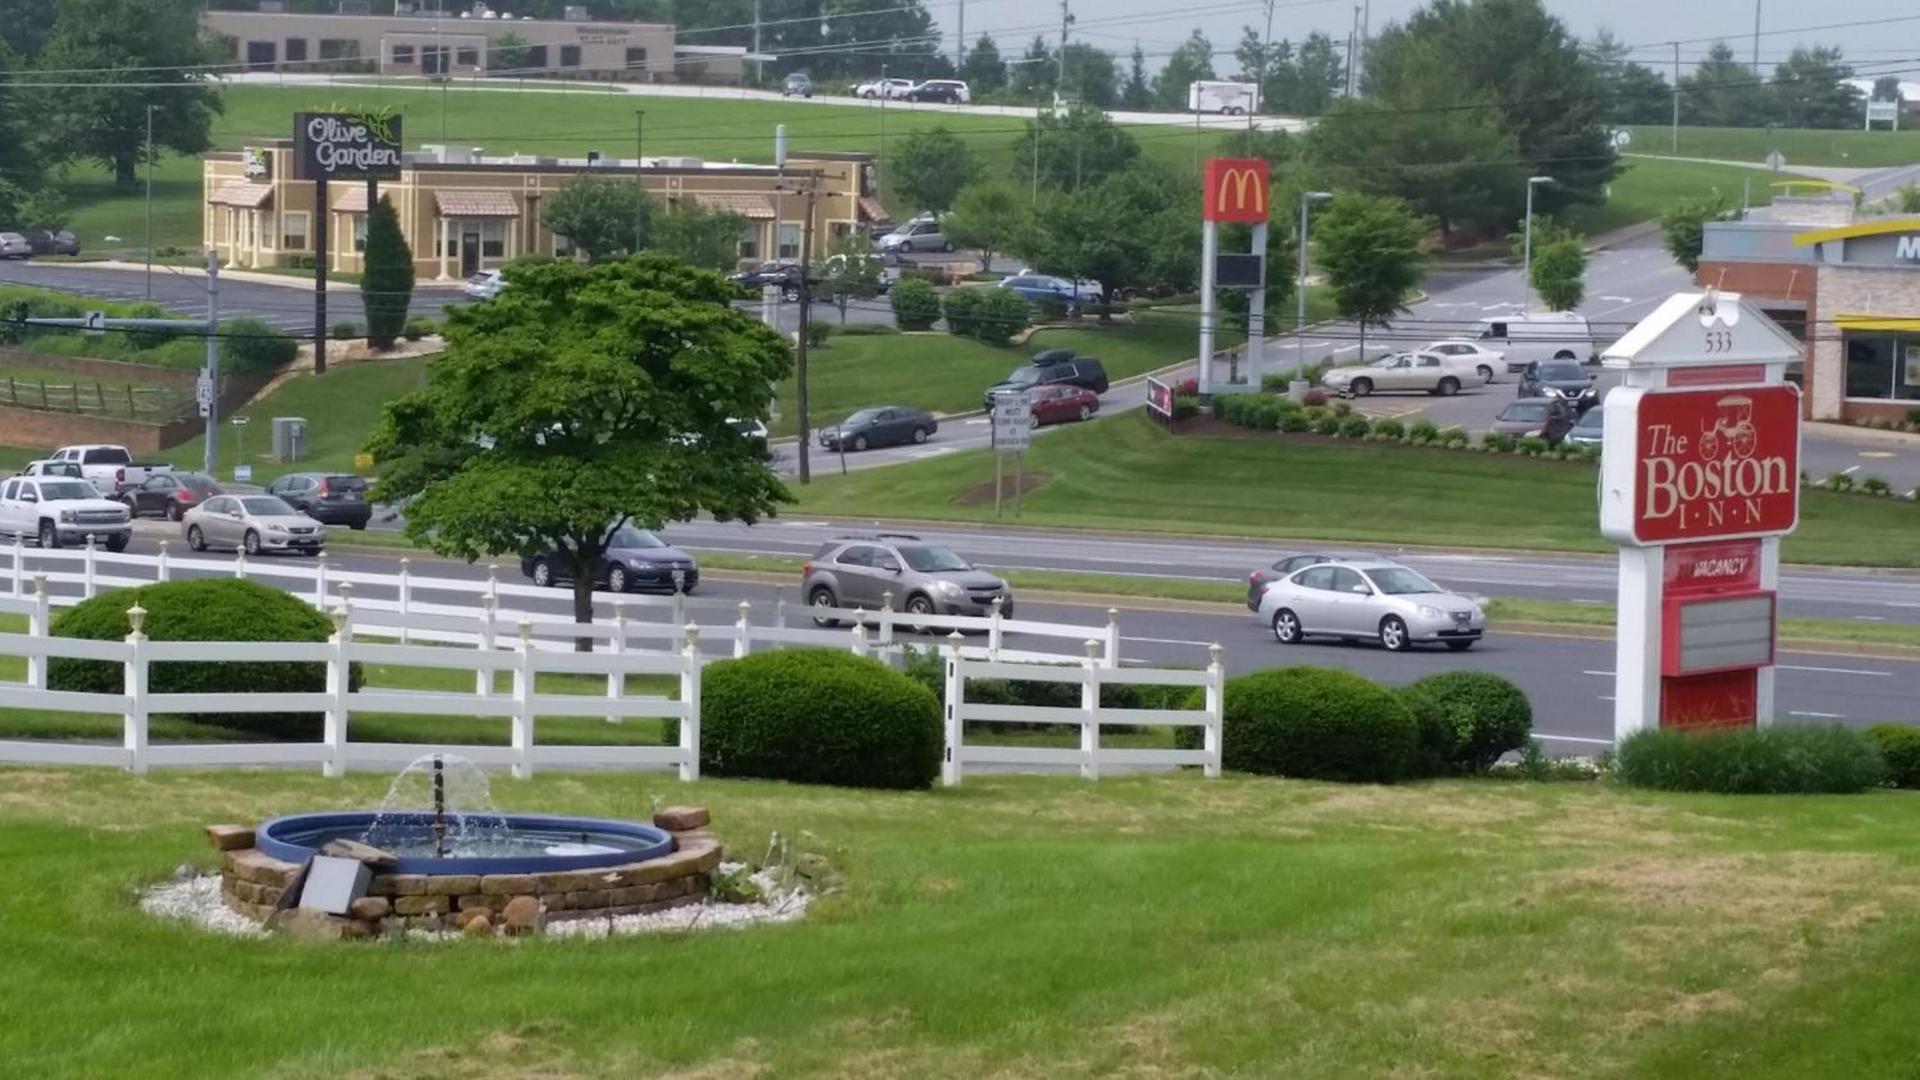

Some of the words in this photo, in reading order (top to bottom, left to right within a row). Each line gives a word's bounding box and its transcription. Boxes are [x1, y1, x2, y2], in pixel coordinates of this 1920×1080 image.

[308, 118, 367, 142] Olive
[316, 142, 399, 172] Garden
[1705, 332, 1732, 352] 533
[1648, 424, 1687, 455] The
[1642, 450, 1789, 519] Boston
[1693, 557, 1748, 577] VACANCY
